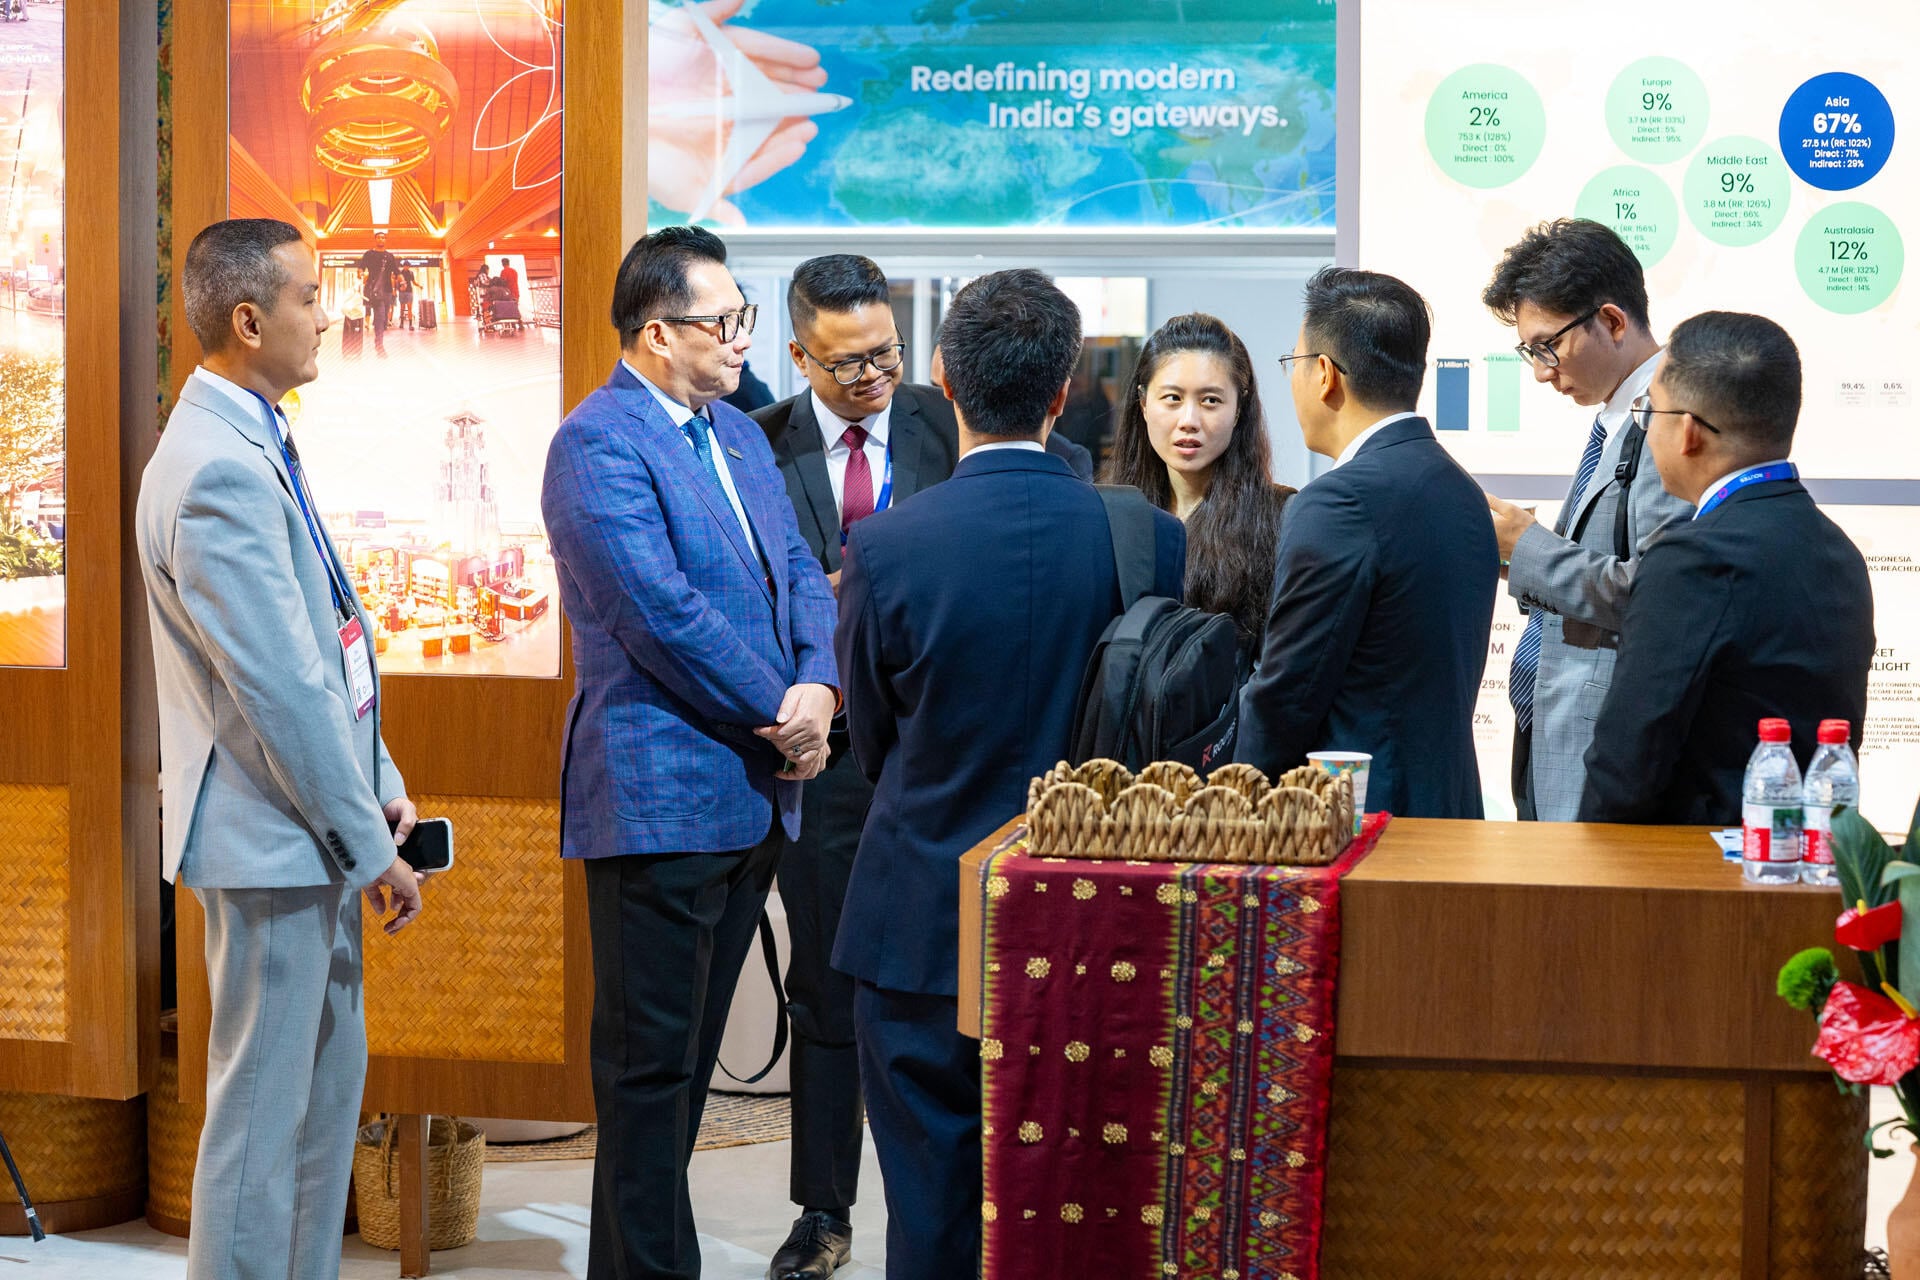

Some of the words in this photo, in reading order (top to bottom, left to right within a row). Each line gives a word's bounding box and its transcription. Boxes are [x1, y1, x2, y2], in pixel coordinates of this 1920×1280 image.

[911, 62, 1090, 99] Redefining
[1100, 63, 1235, 90] modern
[1642, 79, 1672, 87] Europe
[1462, 90, 1508, 100] America
[1642, 92, 1672, 110] 9%
[1825, 96, 1849, 107] Asia
[989, 99, 1101, 128] India's
[1109, 102, 1288, 136] gateways.
[1470, 106, 1500, 126] 2%
[1813, 113, 1862, 134] 67%
[1458, 132, 1473, 141] 753
[1484, 132, 1511, 142] (128%)
[1802, 139, 1819, 147] 27.5
[1821, 139, 1828, 147] M
[1831, 137, 1846, 148] (RR:
[1849, 137, 1871, 148] 102%)
[1815, 149, 1839, 158] Direct
[1845, 149, 1859, 158] 71%
[1707, 156, 1742, 165] Middle
[1746, 156, 1767, 165] East
[1810, 160, 1841, 168] Indirect
[1847, 160, 1864, 168] 29%
[1721, 173, 1754, 192] 9%
[1747, 199, 1771, 208] 126%)
[1616, 203, 1637, 220] 1%
[1830, 241, 1868, 260] 12%
[1858, 265, 1879, 274] 132%)
[1491, 643, 1504, 654] M
[1482, 680, 1506, 689] 29%
